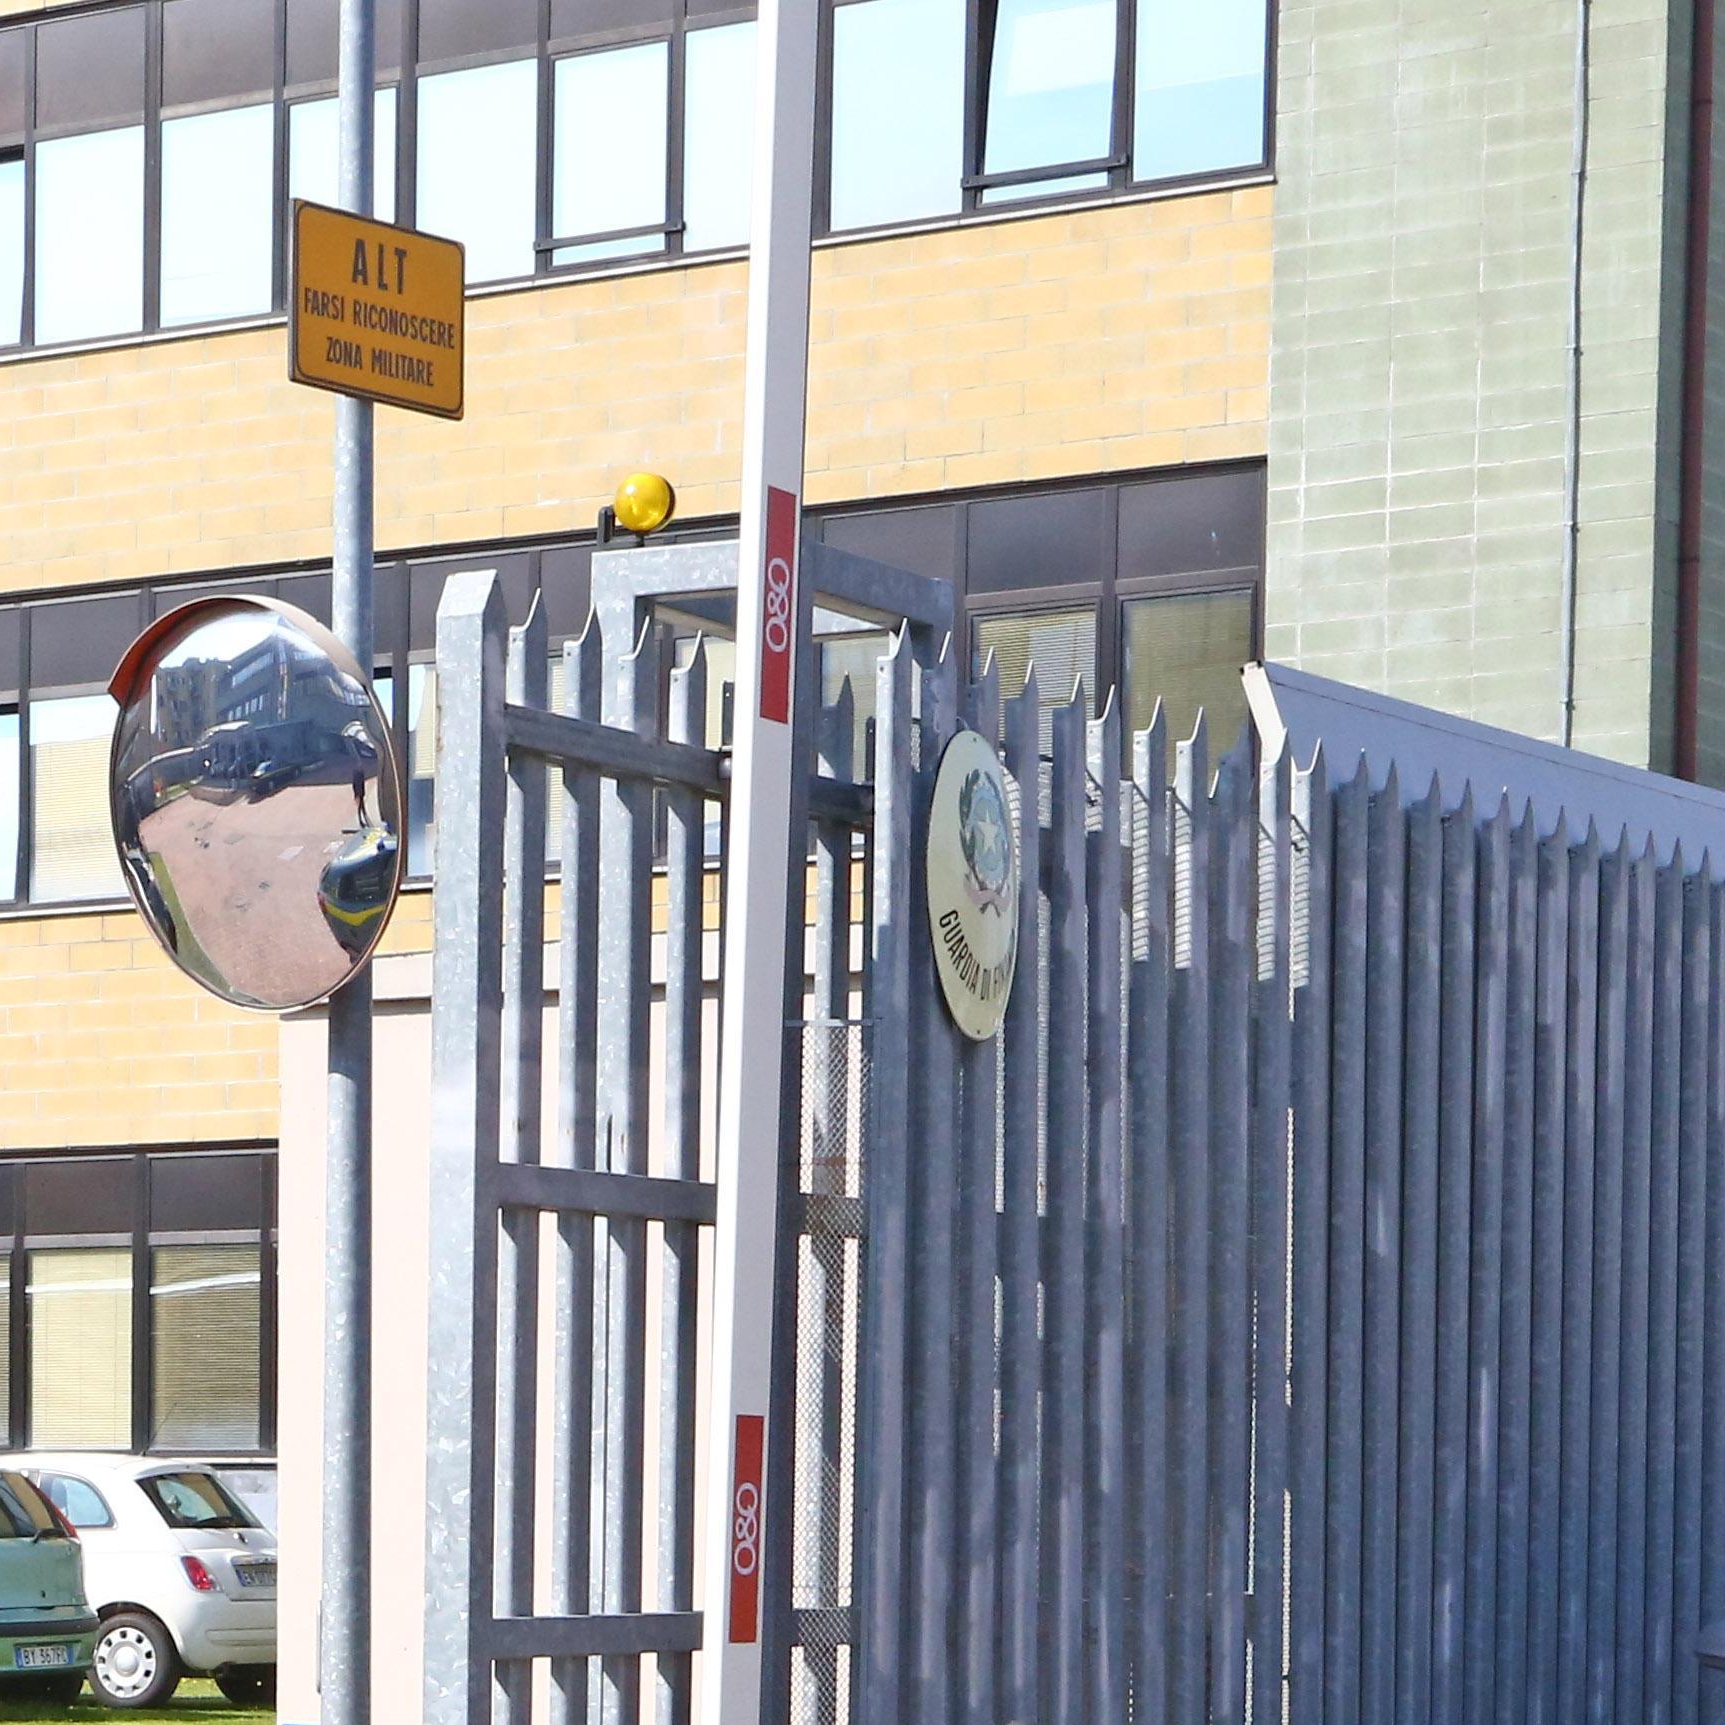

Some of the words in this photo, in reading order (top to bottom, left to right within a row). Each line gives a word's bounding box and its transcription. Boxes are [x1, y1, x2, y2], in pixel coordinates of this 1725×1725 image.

[351, 238, 407, 294] ALT
[304, 287, 345, 322] FARSI
[353, 300, 455, 349] RICONOSCERE
[326, 336, 362, 369] ZONA
[371, 347, 434, 386] MILITARE
[939, 909, 980, 995] GUARDIA
